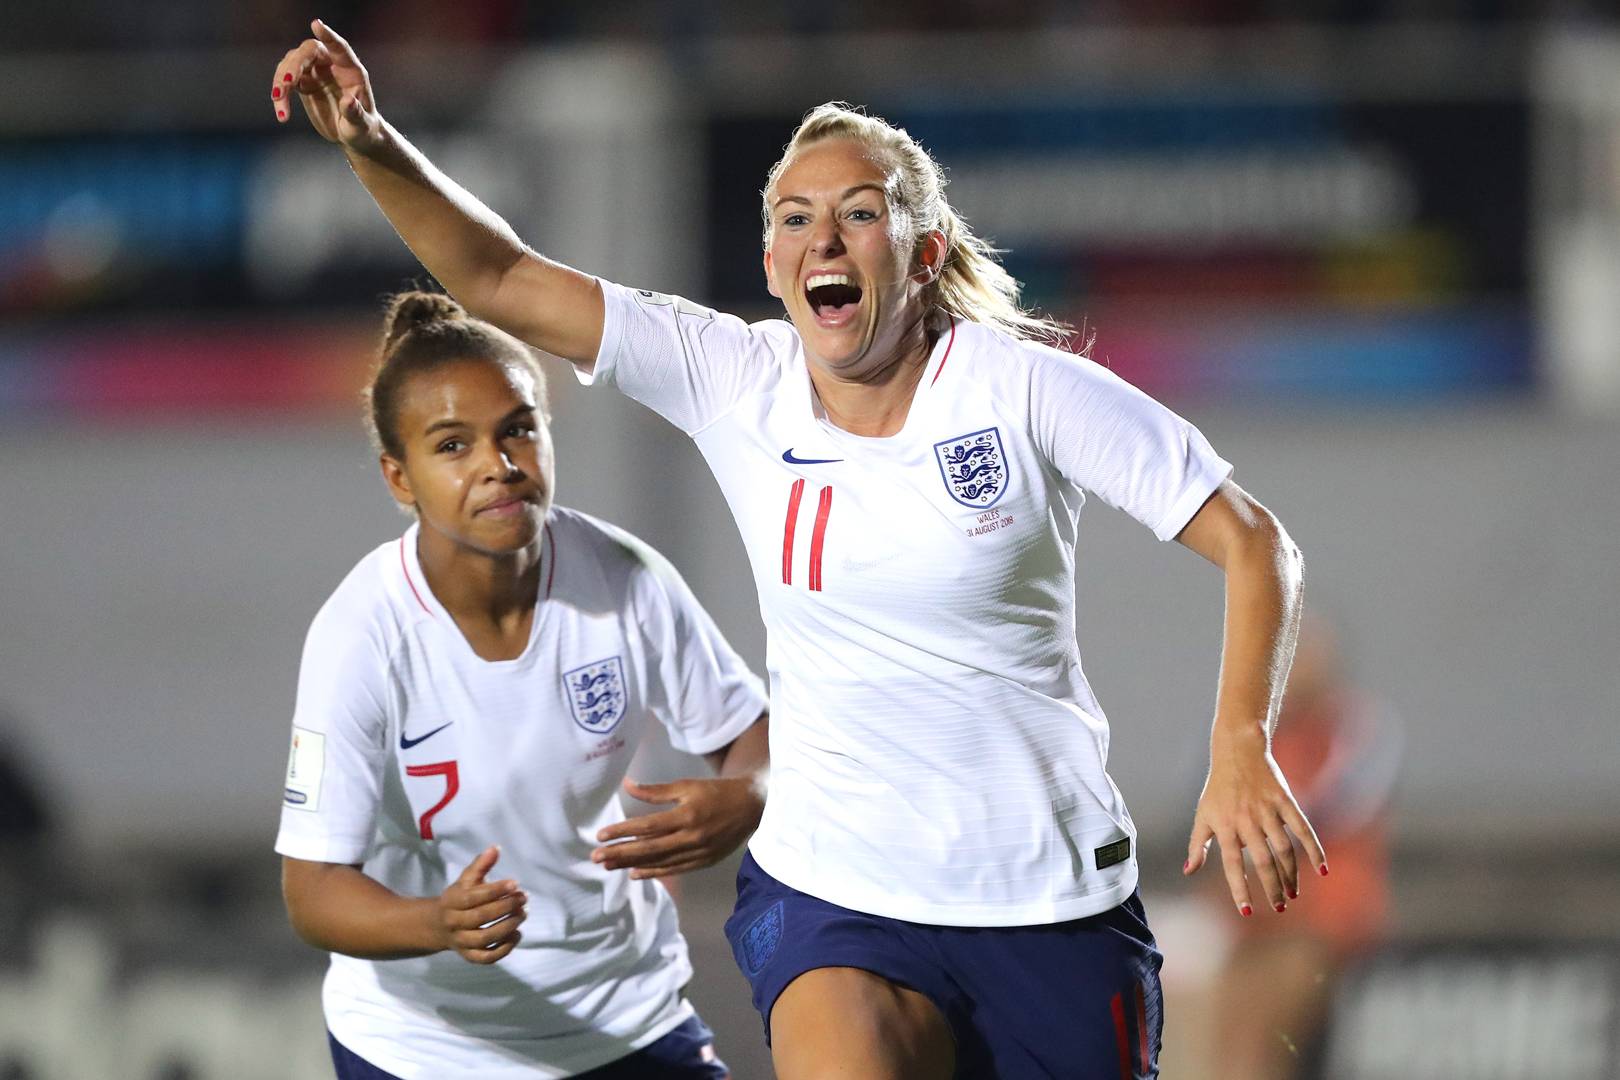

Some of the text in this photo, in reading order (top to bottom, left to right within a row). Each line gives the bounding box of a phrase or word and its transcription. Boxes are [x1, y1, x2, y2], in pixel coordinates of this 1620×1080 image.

[782, 478, 833, 592] 11
[966, 515, 1014, 537] 31 AUGUST 2018
[976, 510, 1000, 524] WALES
[405, 760, 460, 841] 7
